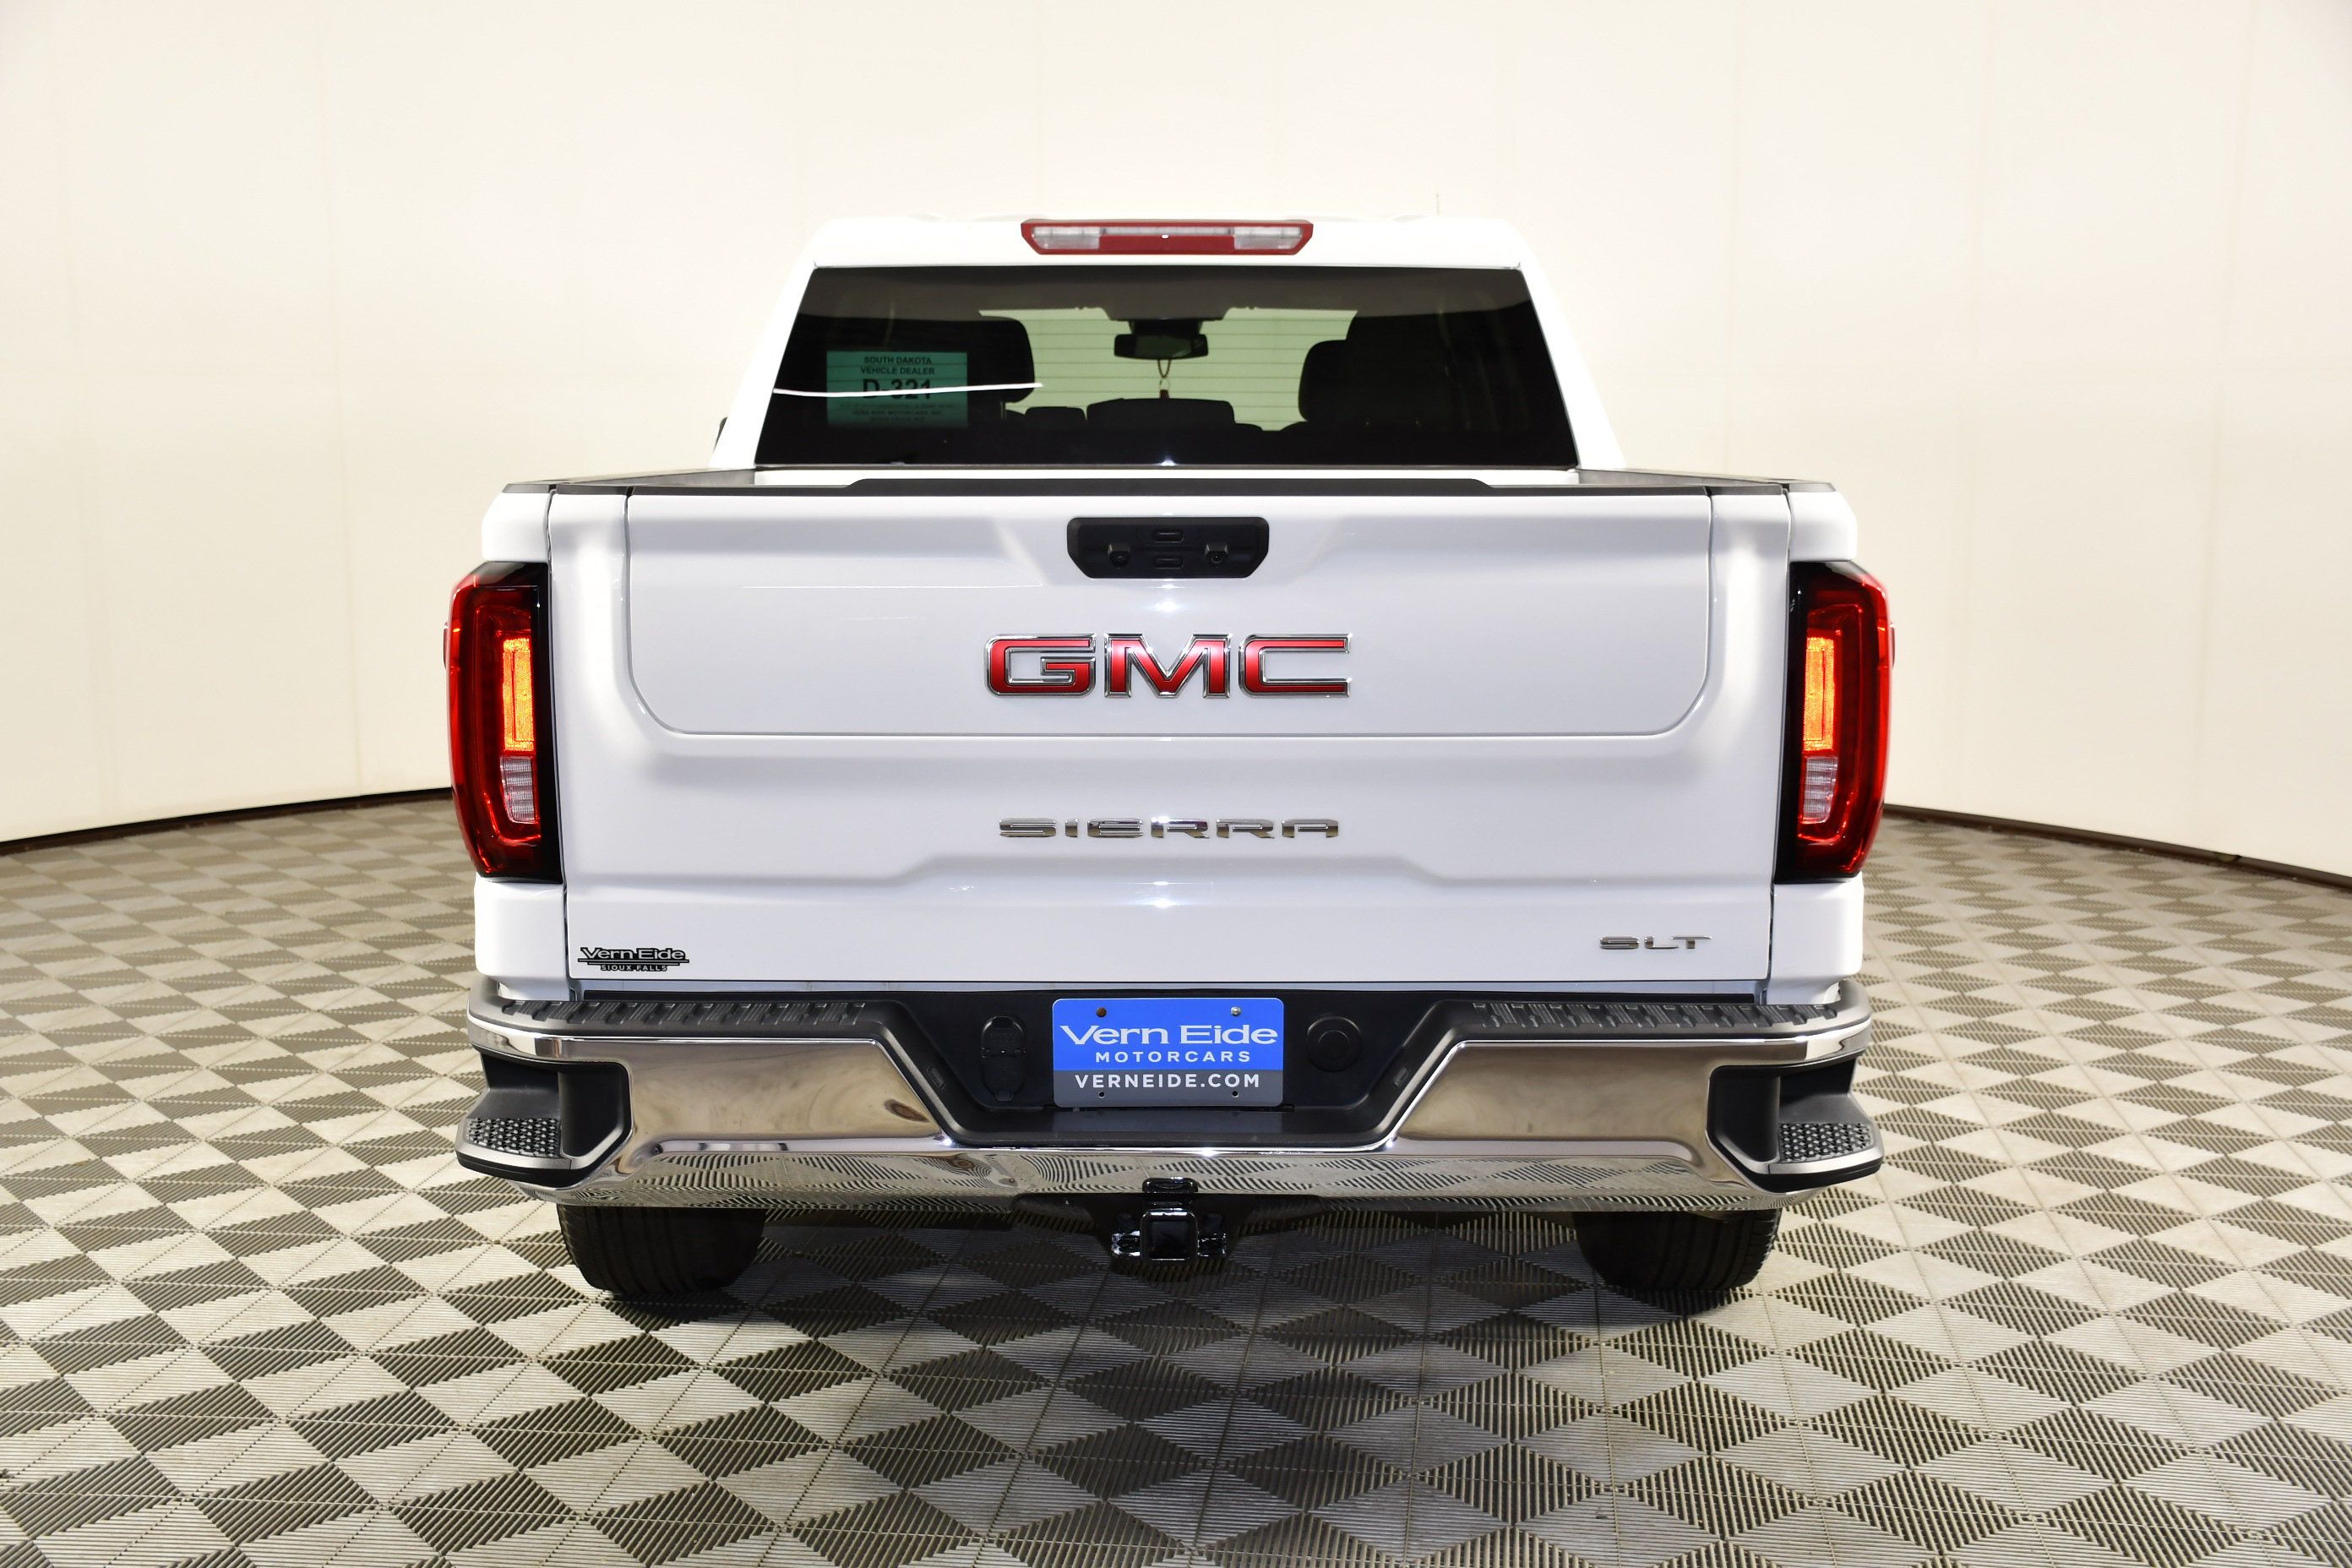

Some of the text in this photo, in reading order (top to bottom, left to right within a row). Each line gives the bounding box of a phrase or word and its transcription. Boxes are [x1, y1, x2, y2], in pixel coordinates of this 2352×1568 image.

[863, 356, 933, 365] SOUTH DAKOTA
[860, 365, 935, 375] VEHICLE DEALER
[863, 378, 931, 400] D321
[984, 633, 1352, 699] GMC
[999, 818, 1340, 840] SIERRA
[1599, 936, 1712, 950] SLT
[580, 947, 685, 961] Vern Eide
[1059, 1024, 1278, 1045] Vern Eide
[1095, 1051, 1251, 1064] MOTORCARS
[1075, 1073, 1260, 1089] VERNEIDE.COM
